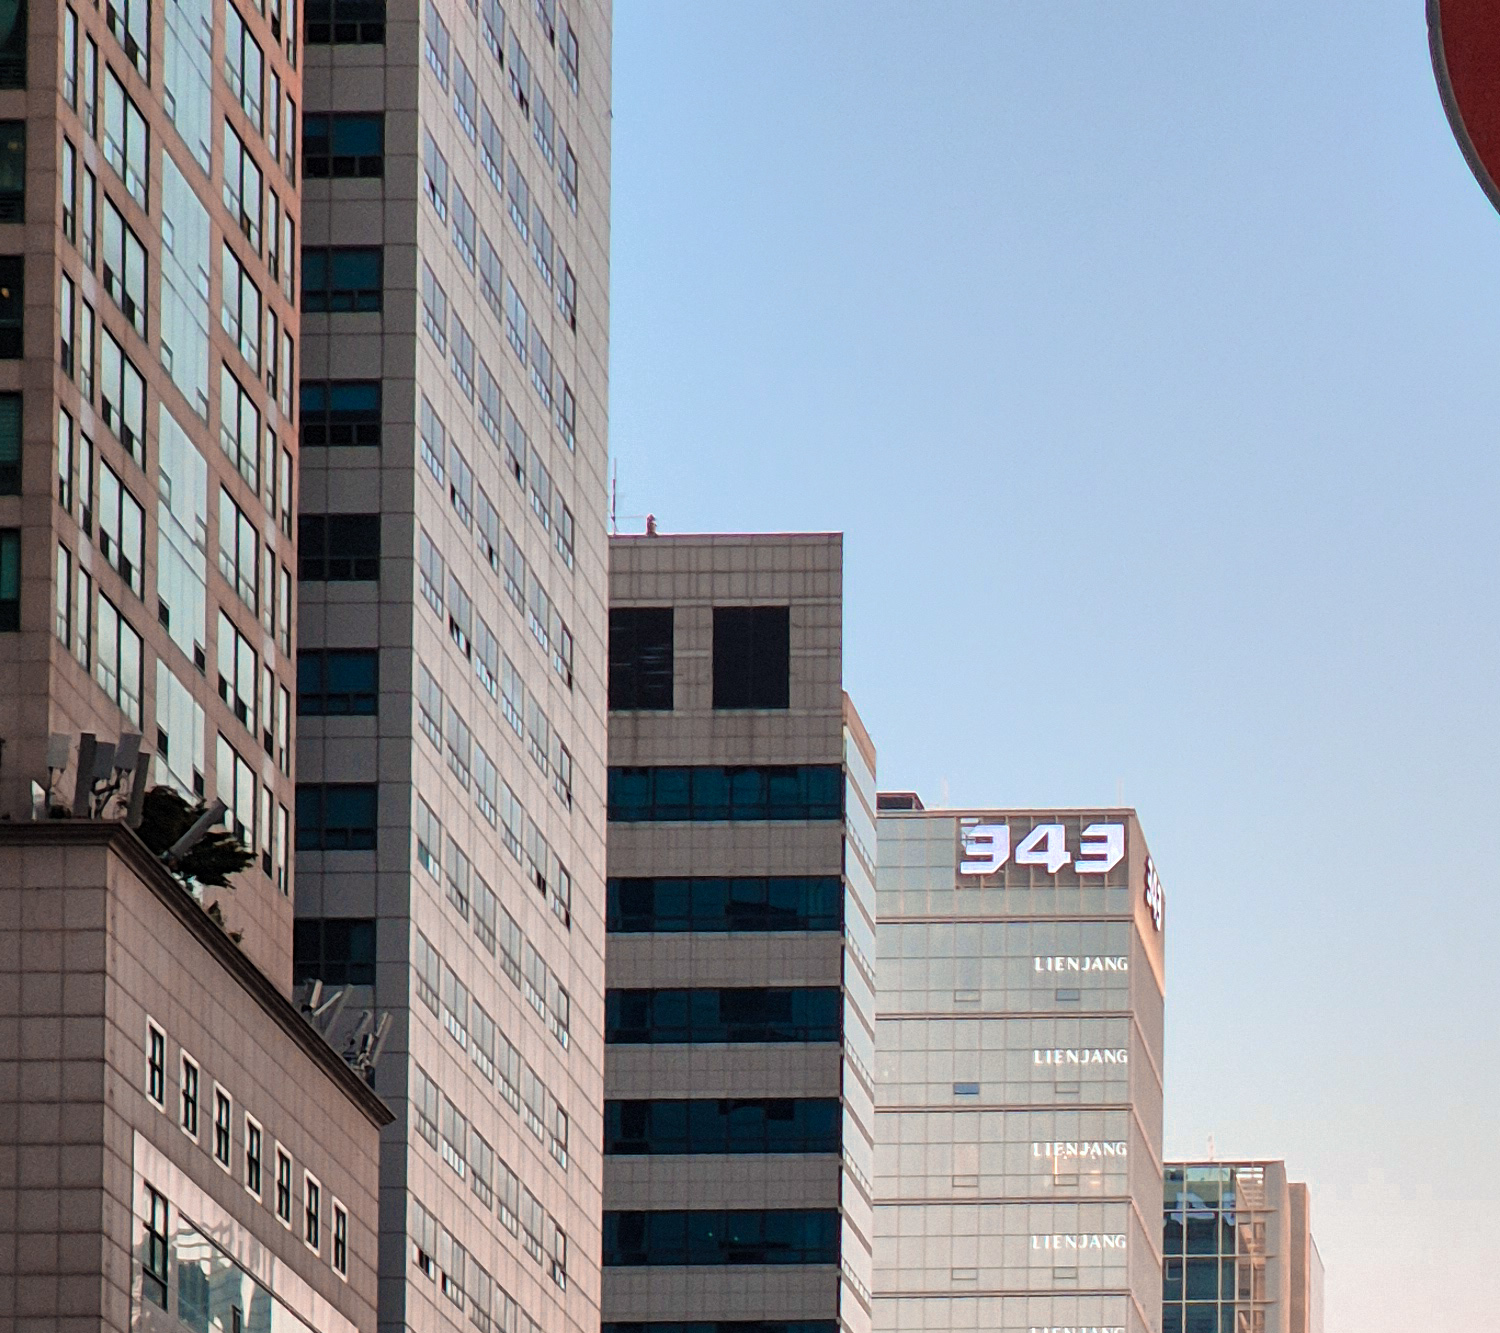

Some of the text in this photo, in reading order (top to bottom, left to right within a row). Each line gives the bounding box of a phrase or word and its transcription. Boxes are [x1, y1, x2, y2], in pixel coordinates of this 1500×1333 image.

[1034, 956, 1128, 971] LIENJANG
[1034, 1049, 1128, 1064] LIENJANG
[1033, 1142, 1127, 1157] LIENJANG
[1032, 1234, 1126, 1250] LIENJANG
